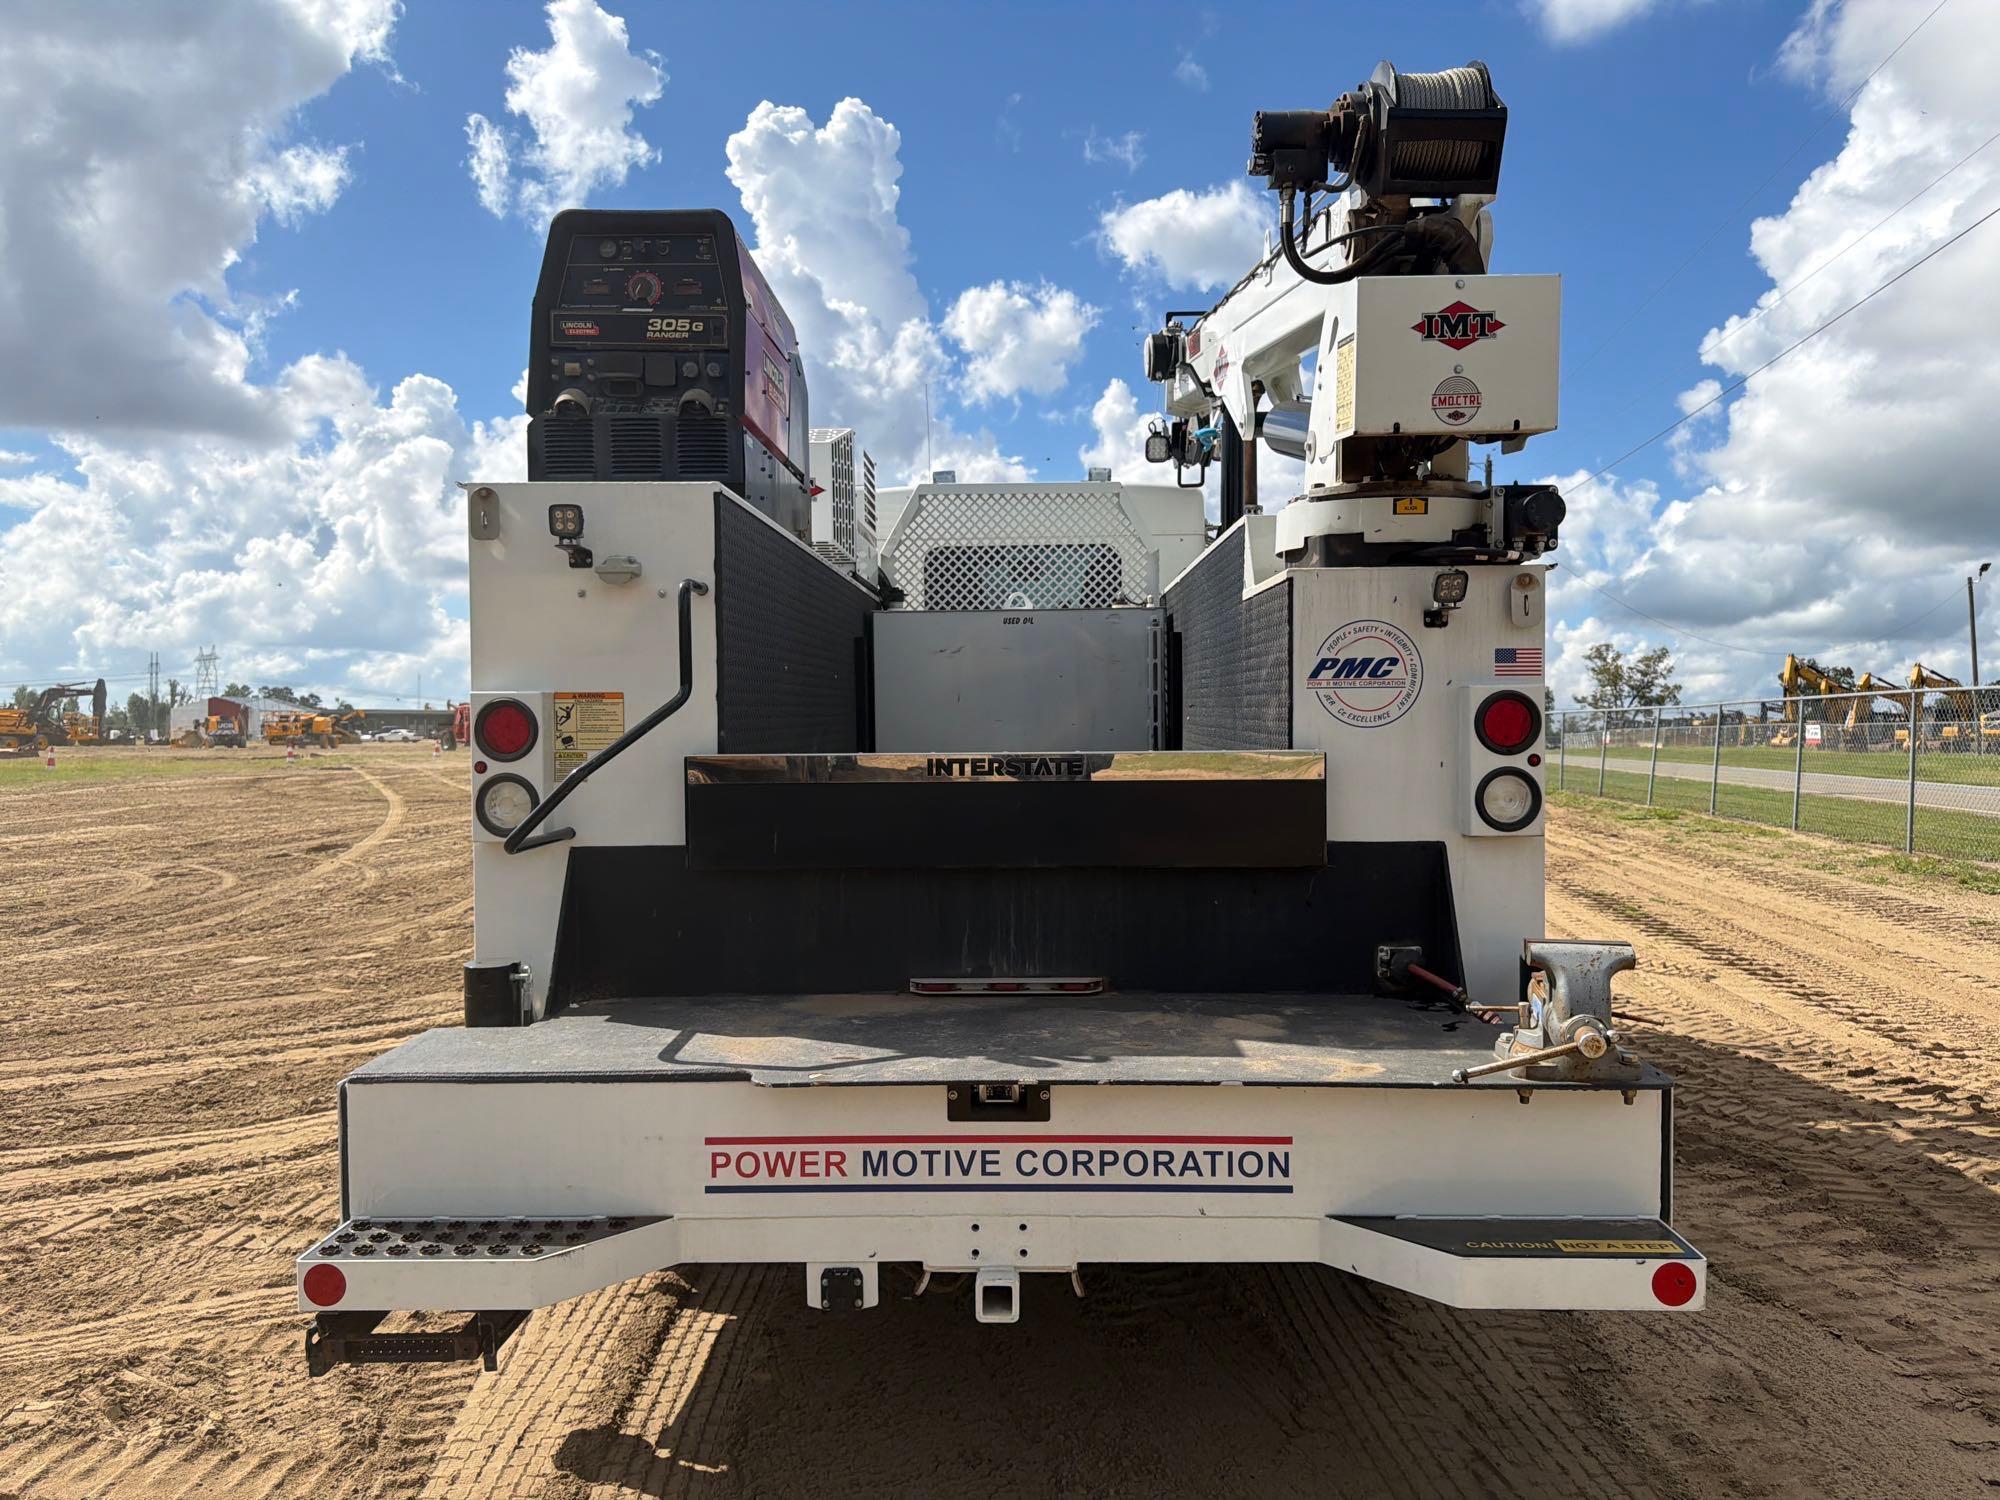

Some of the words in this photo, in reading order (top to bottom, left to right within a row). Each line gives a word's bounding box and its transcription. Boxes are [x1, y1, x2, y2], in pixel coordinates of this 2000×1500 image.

[646, 331, 689, 339] RANGER
[1422, 312, 1495, 340] IMT
[1002, 616, 1021, 625] USED
[1352, 625, 1380, 635] SAFETY
[1326, 631, 1348, 653] PEOPLE
[1383, 628, 1414, 657] INTEGRITY
[1308, 656, 1400, 679] PMC
[1397, 663, 1418, 711] COMMITMENT
[1347, 710, 1392, 723] EXCELLENCE
[927, 757, 1084, 777] INTERSTATE
[710, 1150, 848, 1179] POWER
[862, 1149, 1001, 1178] MOTIVE
[1015, 1149, 1291, 1178] CORPORATION
